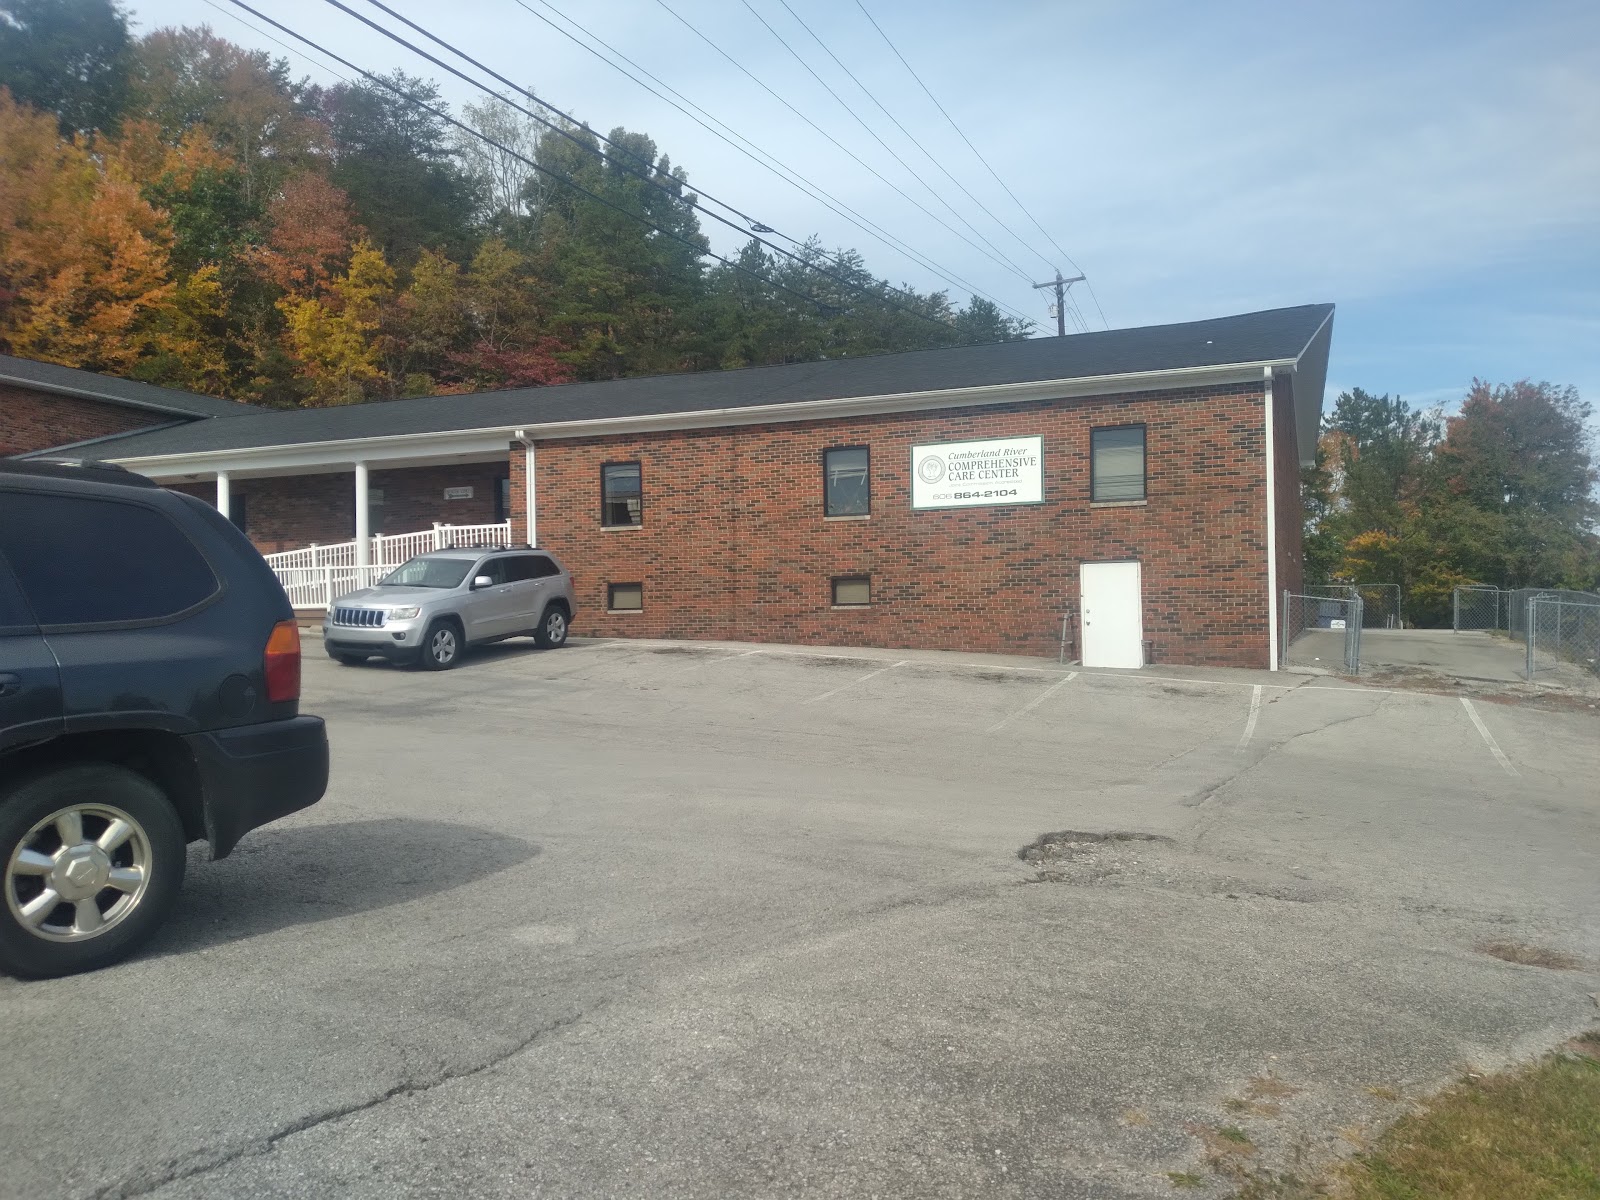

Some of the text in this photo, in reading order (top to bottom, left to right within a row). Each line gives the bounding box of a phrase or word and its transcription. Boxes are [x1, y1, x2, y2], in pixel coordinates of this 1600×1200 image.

[948, 447, 1028, 460] Cumberland River
[948, 456, 1037, 472] COMPREHENSIVE
[948, 468, 1019, 482] CARE CENTER
[953, 489, 1018, 500] 864-2104
